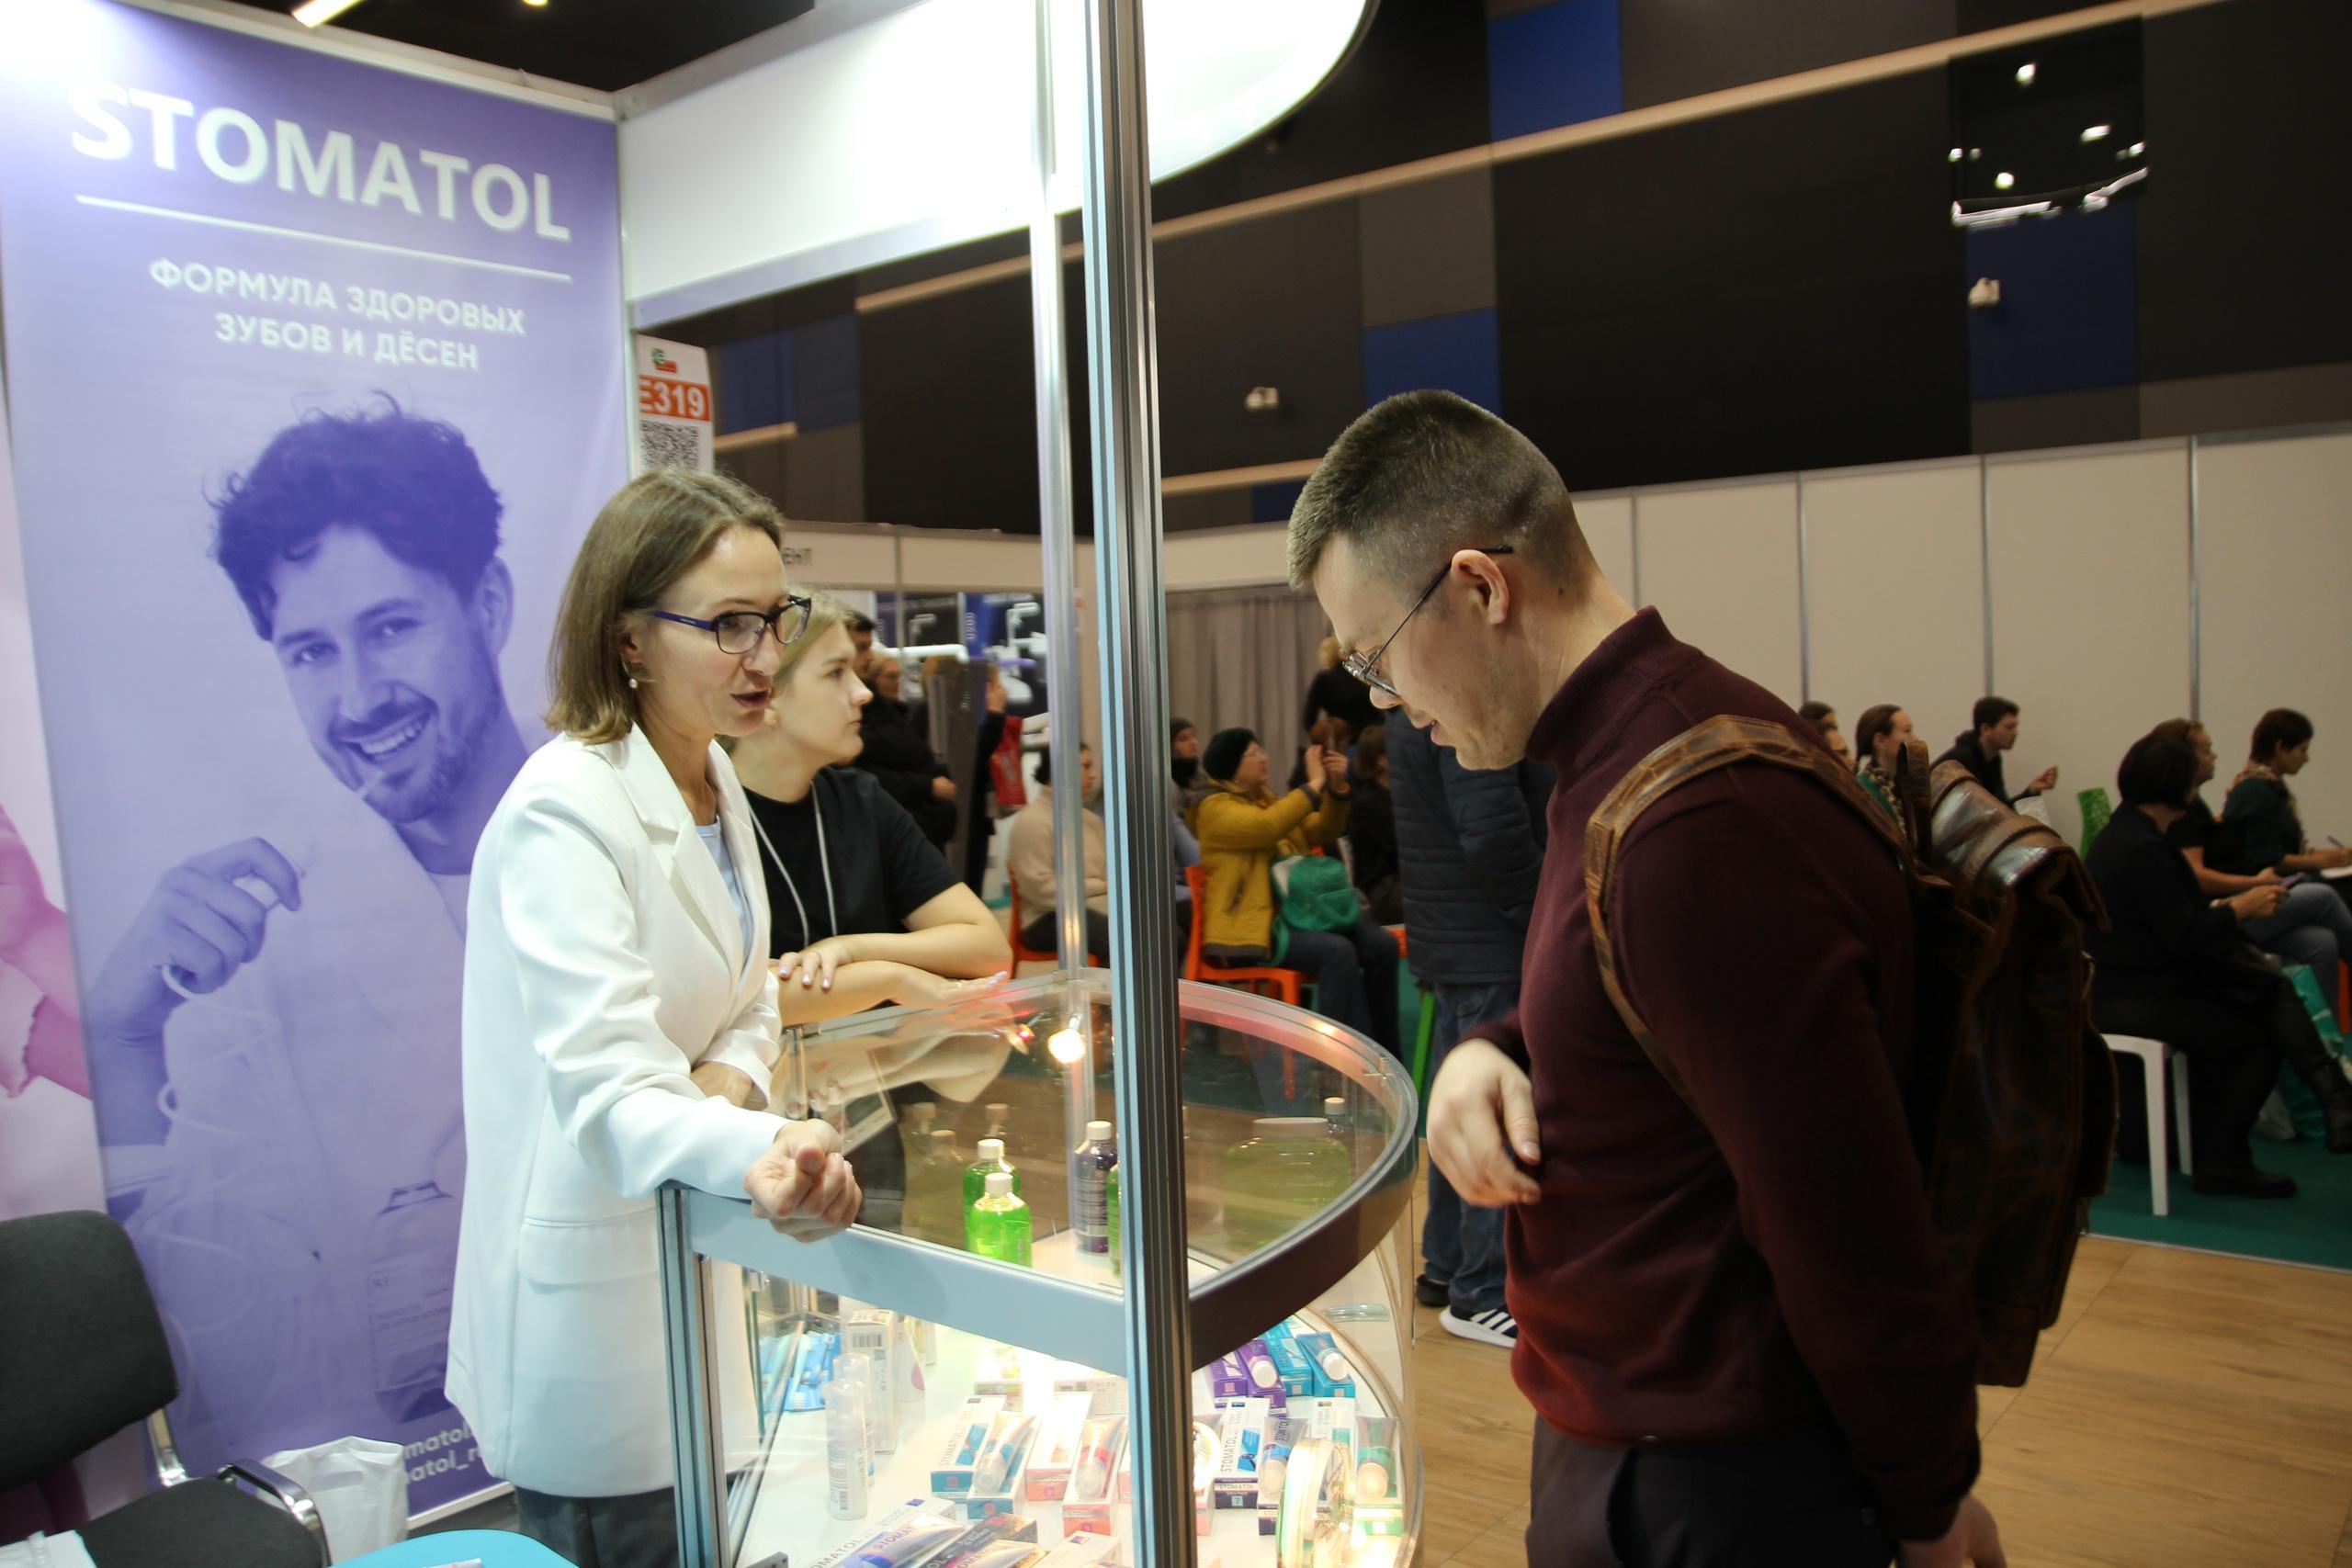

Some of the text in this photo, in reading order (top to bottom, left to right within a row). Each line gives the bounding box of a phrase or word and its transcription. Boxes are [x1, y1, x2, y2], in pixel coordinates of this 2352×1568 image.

[70, 81, 571, 241] STOMATOL
[149, 257, 526, 335] ФОРМУЛА ЗДОРОВЫХ
[214, 312, 479, 370] ЗУБОВ И ДЁСЕН
[639, 379, 705, 418] E319
[404, 1421, 471, 1460] matol
[1220, 1434, 1237, 1472] STOMATOL
[809, 1538, 861, 1568] OMATOL
